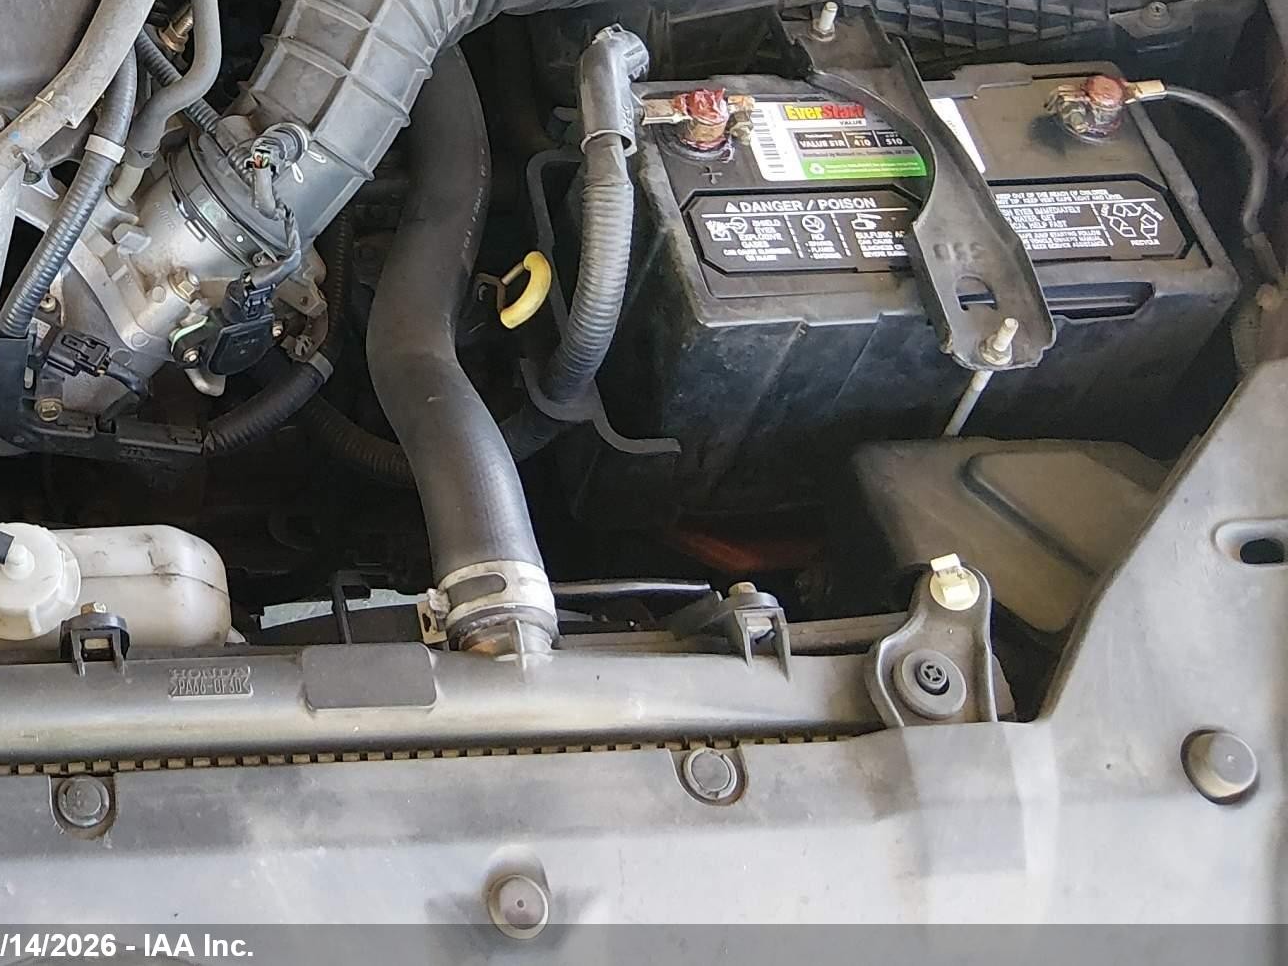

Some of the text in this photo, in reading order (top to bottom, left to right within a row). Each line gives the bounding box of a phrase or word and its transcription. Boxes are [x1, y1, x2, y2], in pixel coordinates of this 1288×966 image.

[783, 104, 866, 120] EverStart
[799, 139, 828, 147] VALUE
[739, 200, 804, 213] DANGER
[817, 197, 877, 211] POISON
[1034, 206, 1081, 214] IMMEDIATELY
[1029, 221, 1049, 229] HELP
[1050, 220, 1069, 228] FAST
